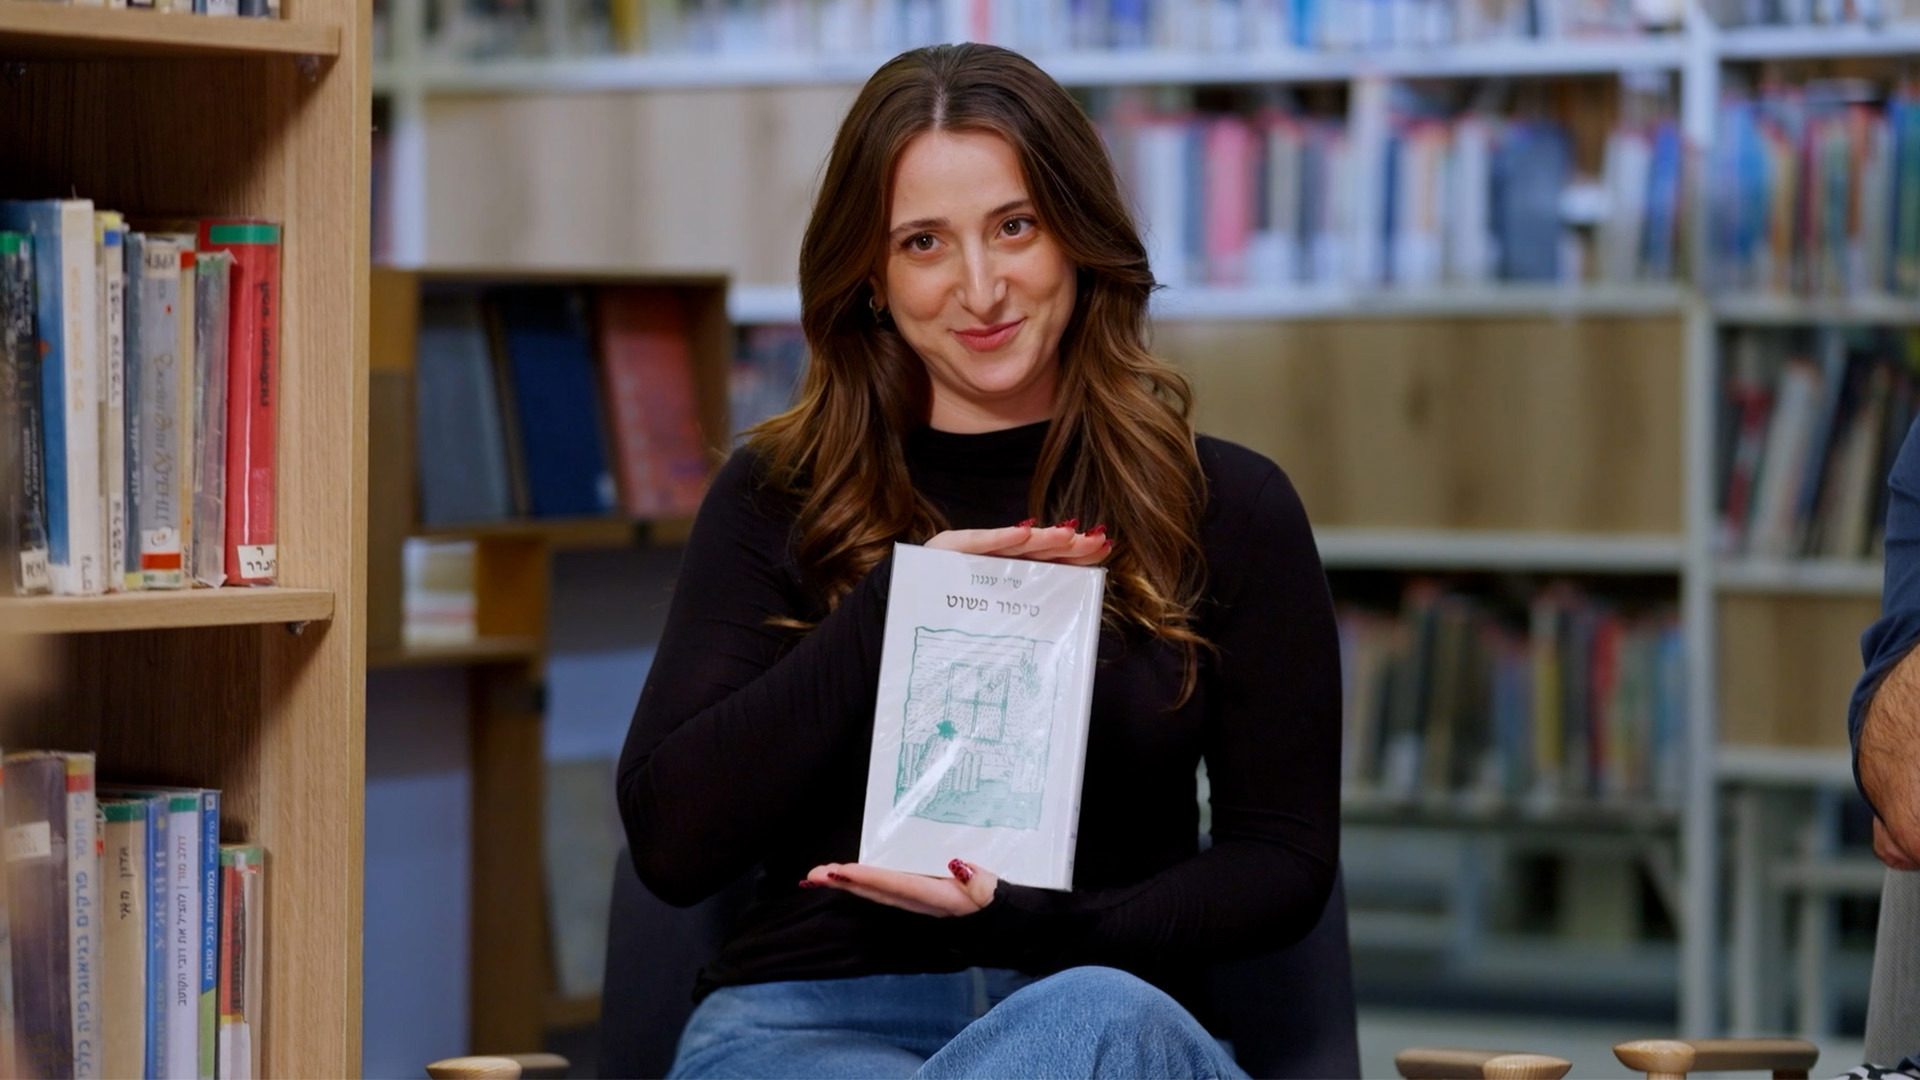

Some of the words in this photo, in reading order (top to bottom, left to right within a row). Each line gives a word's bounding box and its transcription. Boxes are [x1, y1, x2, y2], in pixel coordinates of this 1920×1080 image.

[152, 450, 173, 522] КРЕНЦ
[971, 573, 998, 587] עגנון
[1003, 577, 1022, 589] ש"י
[947, 595, 988, 612] פשוט
[996, 600, 1040, 618] סיפור
[177, 836, 187, 860] דולב
[119, 846, 135, 879] אדון
[177, 864, 187, 881] מור
[75, 871, 91, 928] פרקים
[119, 891, 131, 920] האי
[177, 893, 187, 924] להציל
[206, 870, 215, 923] במשפחות
[177, 928, 187, 943] את
[206, 926, 214, 945] הכי
[177, 946, 187, 968] דובי
[205, 949, 214, 980] טובות
[76, 935, 91, 1033] בגיאוגרפיה
[177, 971, 188, 1006] הקוטב
